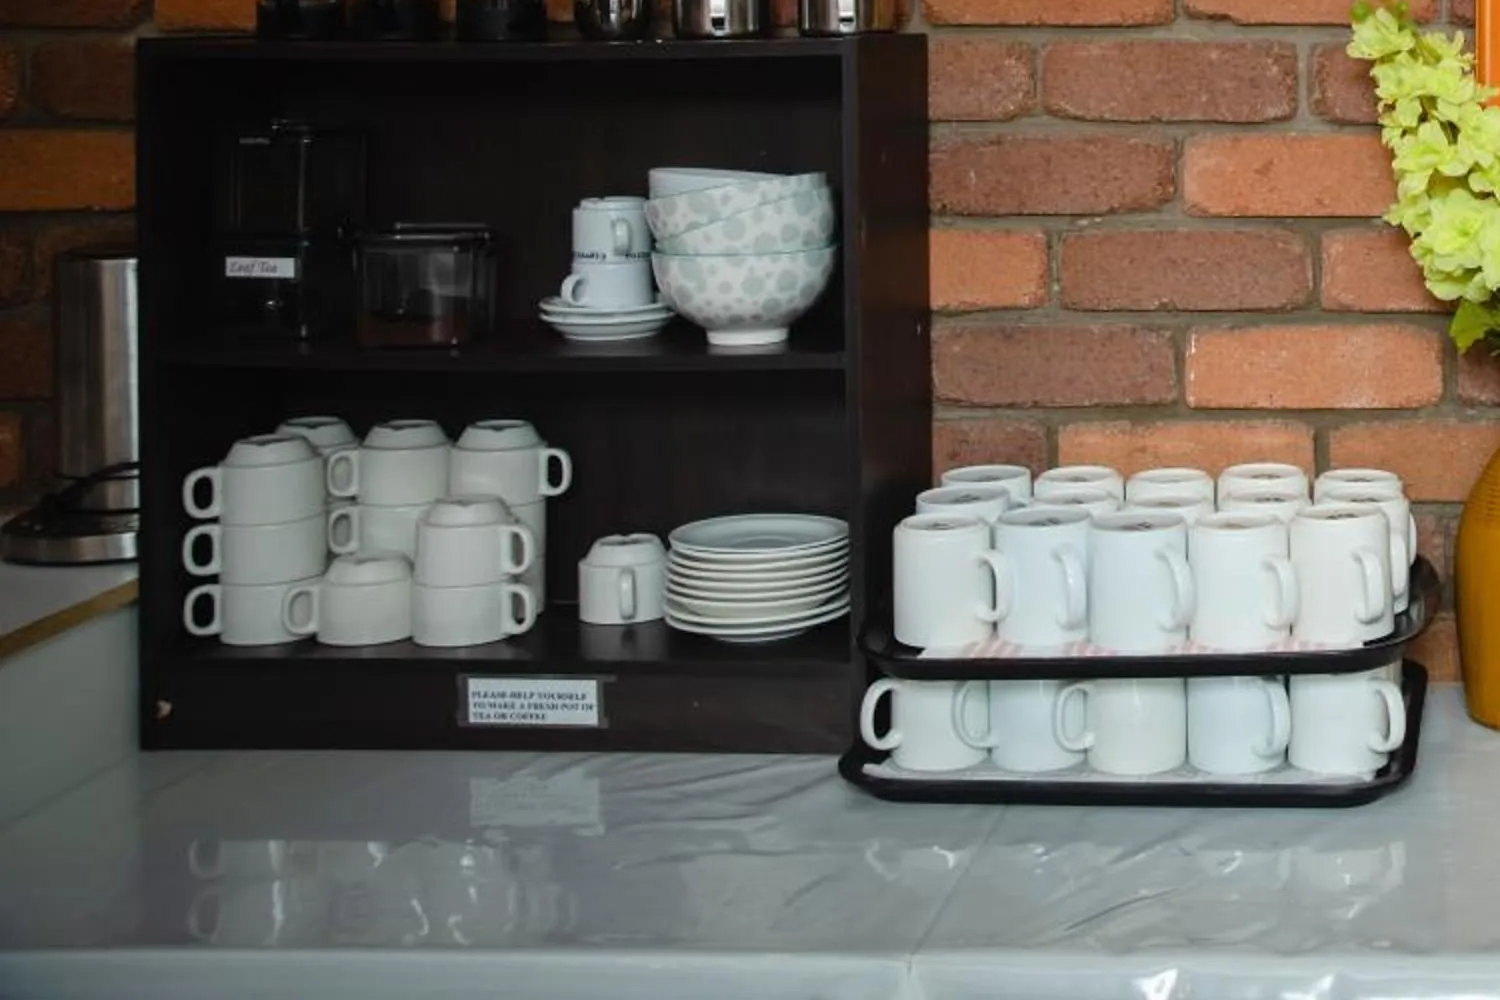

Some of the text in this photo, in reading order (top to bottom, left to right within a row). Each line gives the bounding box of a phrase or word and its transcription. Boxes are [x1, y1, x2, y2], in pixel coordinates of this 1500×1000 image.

[471, 690, 587, 701] PLEASE HELP YOURSELF
[472, 702, 486, 710] TO
[487, 702, 516, 711] MAKE
[527, 702, 559, 711] FRESH
[561, 703, 579, 711] POT
[473, 712, 546, 721] TEA OR COFFEE
